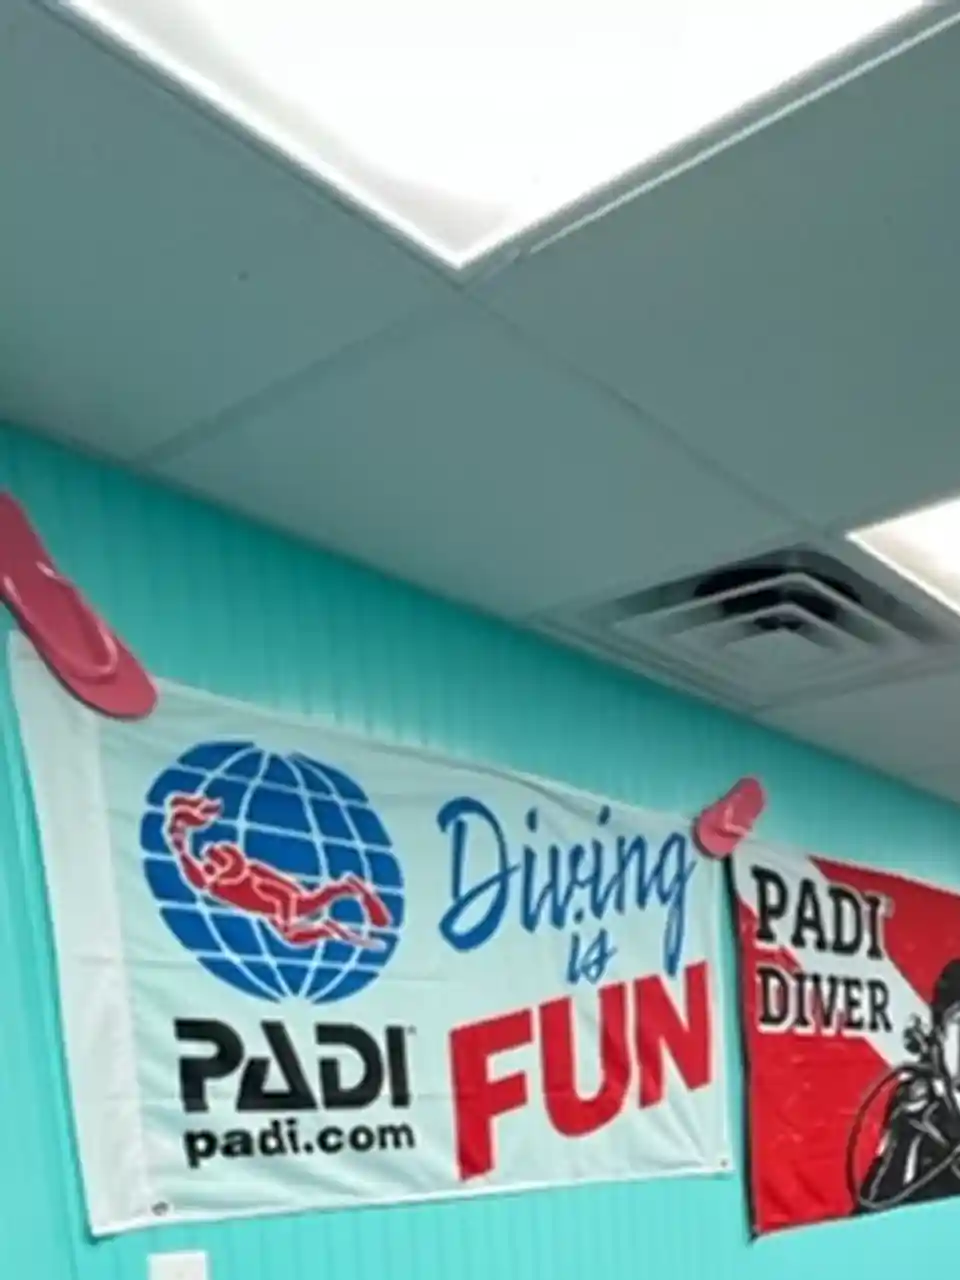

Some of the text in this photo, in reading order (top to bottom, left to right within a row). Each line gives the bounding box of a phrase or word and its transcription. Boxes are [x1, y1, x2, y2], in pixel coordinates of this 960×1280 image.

[437, 797, 697, 975] Diving
[751, 866, 886, 959] PADI
[566, 911, 617, 983] is
[756, 967, 893, 1032] DIVER
[173, 1018, 412, 1113] PADI
[449, 962, 712, 1181] FUN
[184, 1121, 415, 1168] padi.com
